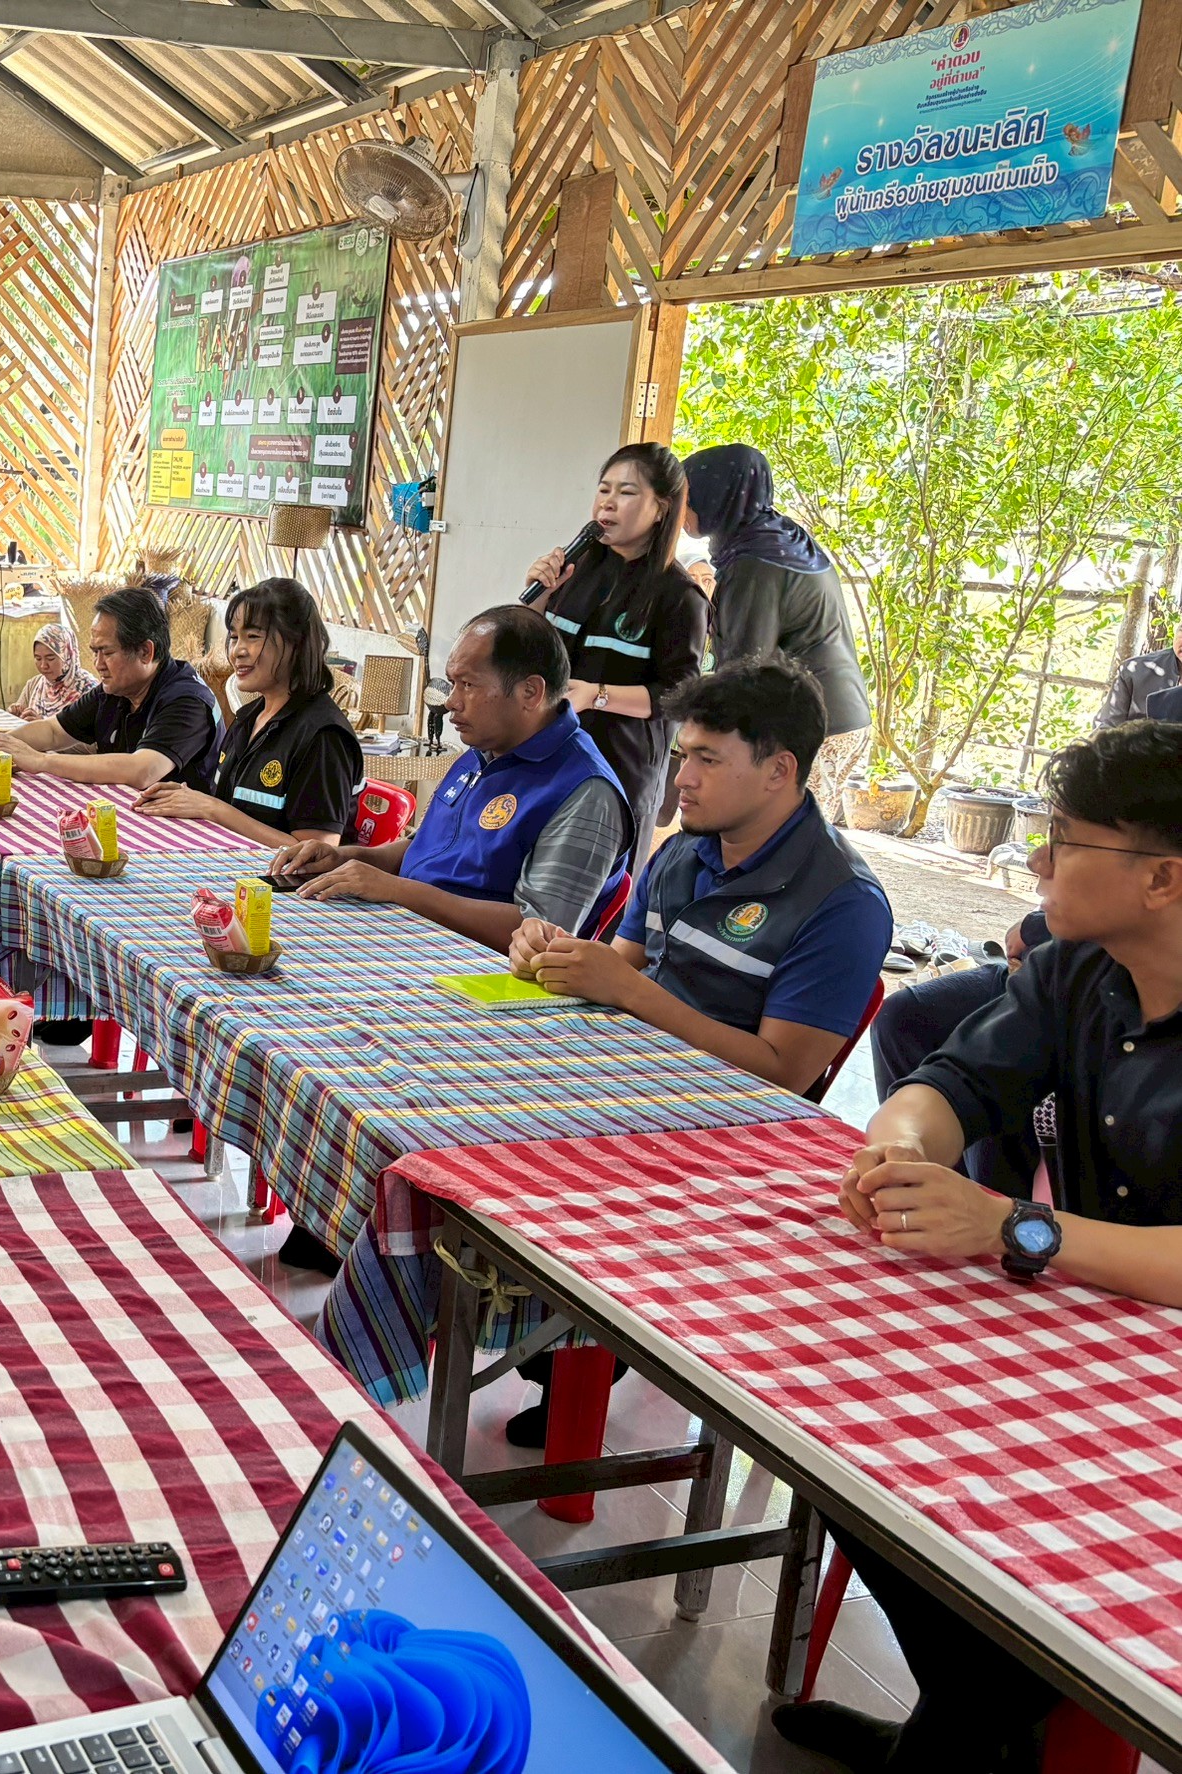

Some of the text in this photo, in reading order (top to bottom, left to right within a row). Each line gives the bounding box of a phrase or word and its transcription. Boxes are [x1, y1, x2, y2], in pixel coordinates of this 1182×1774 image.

[857, 108, 1048, 175] รางวัลชนะเลิศ
